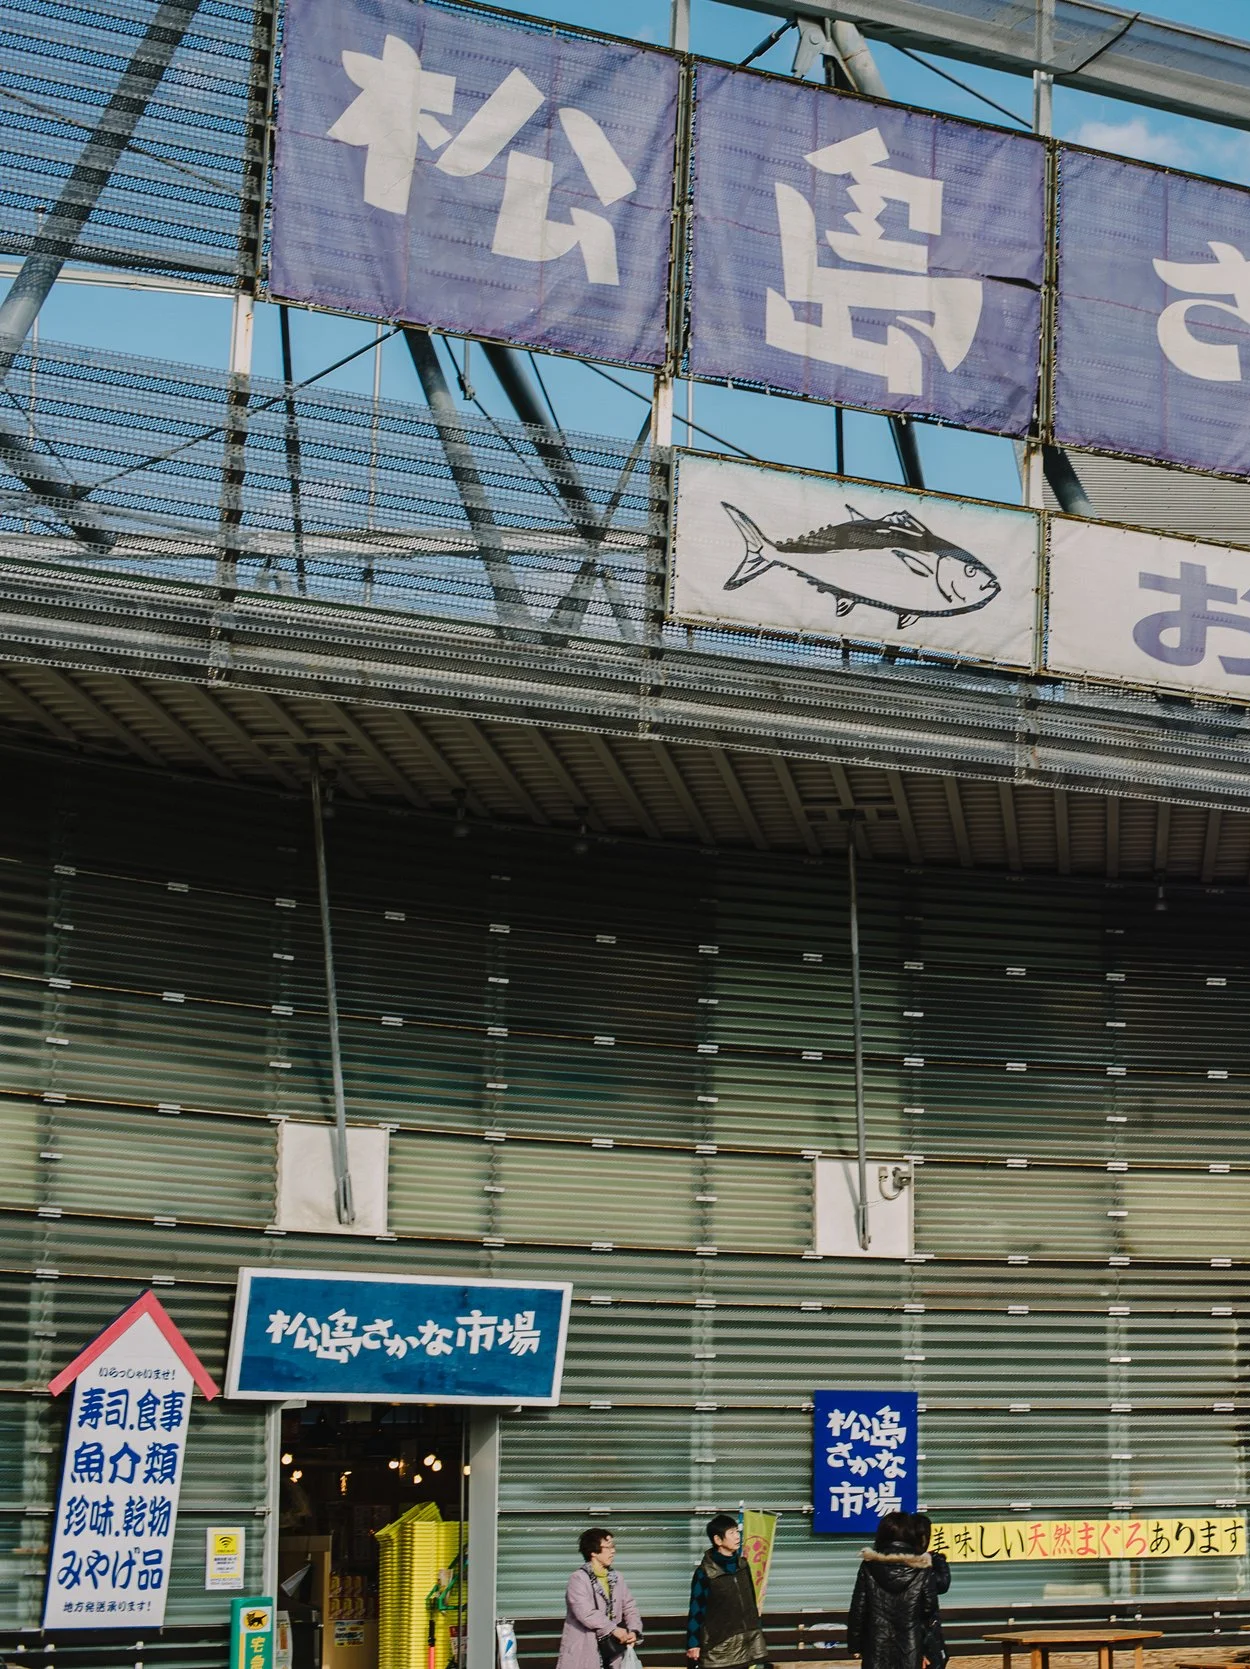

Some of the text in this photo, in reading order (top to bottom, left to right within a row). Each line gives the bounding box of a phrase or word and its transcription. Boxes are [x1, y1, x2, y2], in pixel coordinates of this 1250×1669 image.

[266, 1308, 541, 1364] 松島さかな市場
[826, 1405, 907, 1449] 松島
[70, 1441, 180, 1485] 魚介類
[826, 1442, 907, 1479] さかな
[829, 1481, 902, 1518] 市場
[932, 1519, 1244, 1559] 美味しい天然まぐろあります
[57, 1547, 163, 1591] みやげ品
[62, 1600, 152, 1613] 地方発送承ります!
